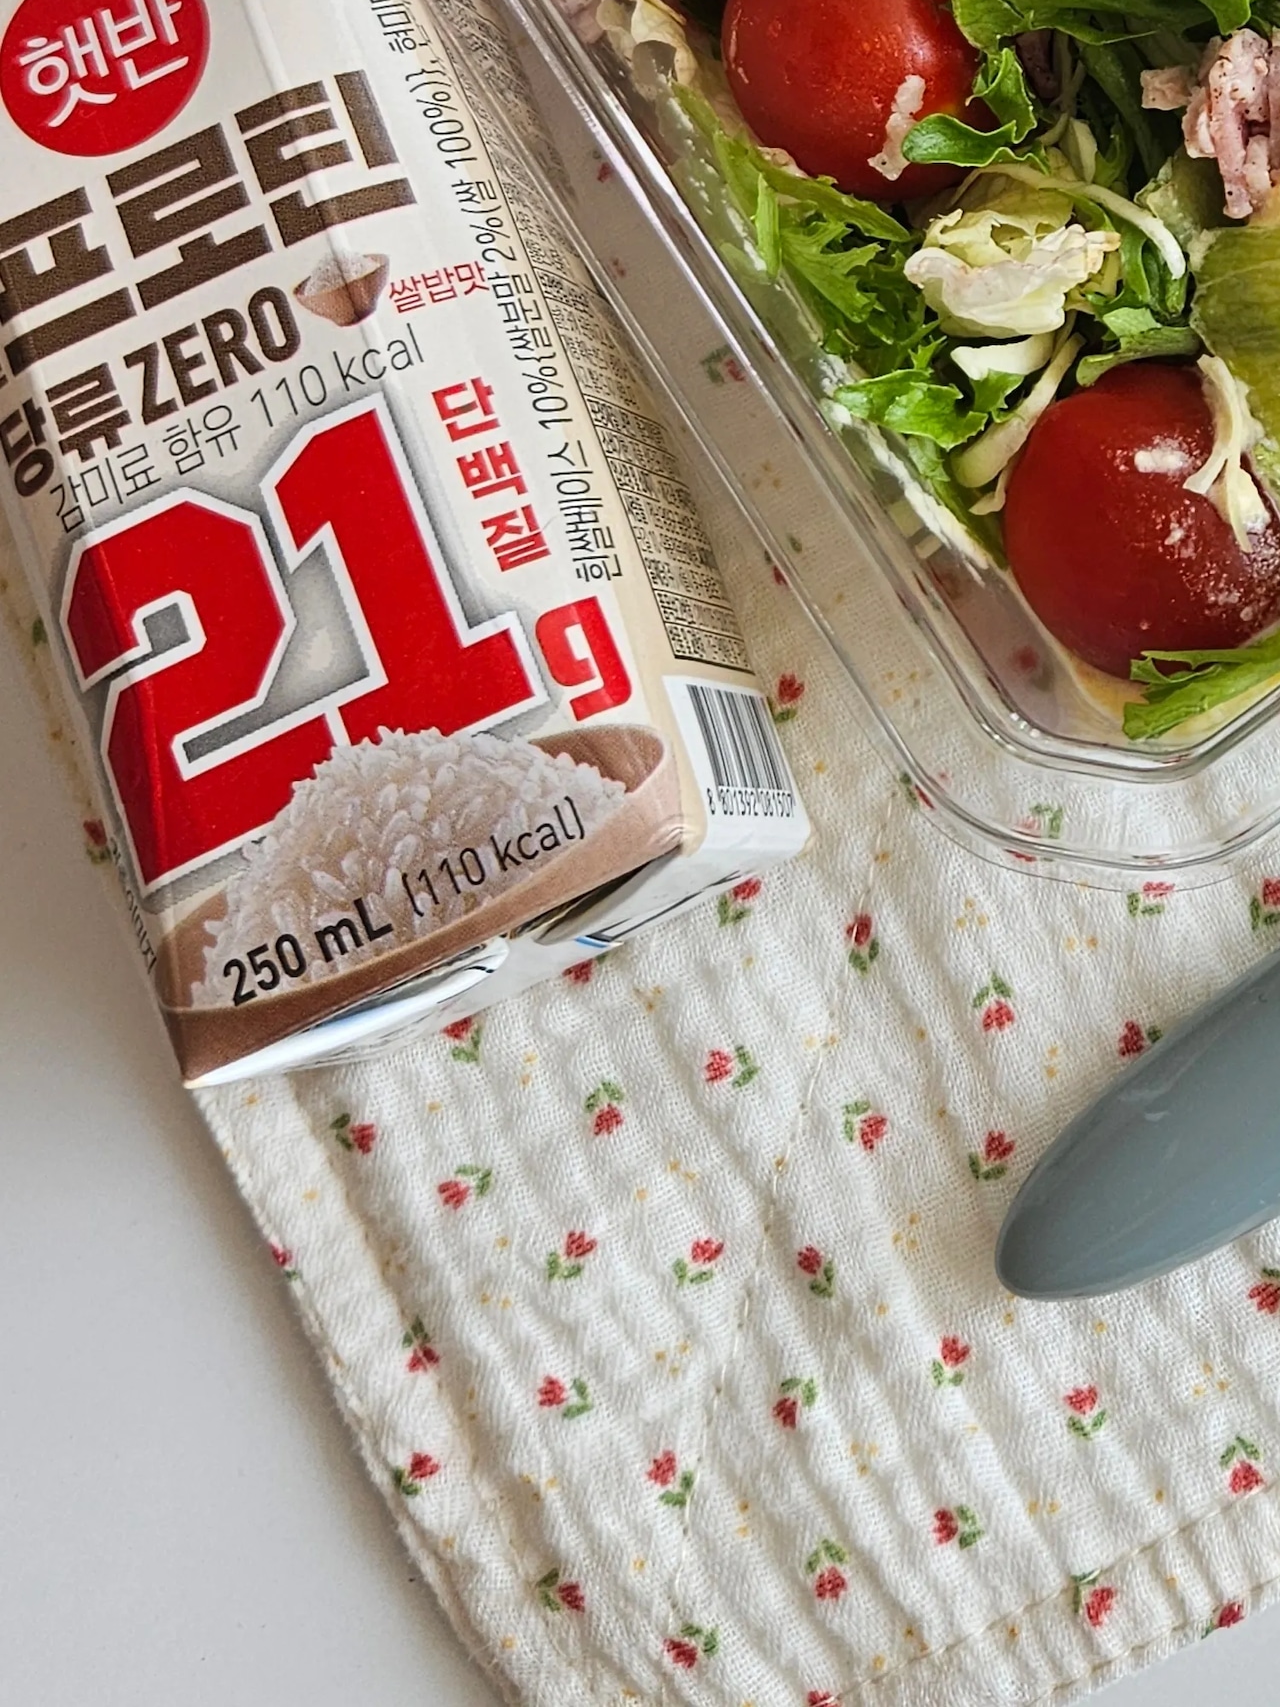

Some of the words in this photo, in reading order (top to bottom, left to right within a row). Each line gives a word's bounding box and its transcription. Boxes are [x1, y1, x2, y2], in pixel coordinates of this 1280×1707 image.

[123, 286, 301, 426] ZERO
[388, 260, 490, 314] 쌀밥맛
[50, 443, 161, 533] 감미료
[162, 404, 242, 476] 함유
[249, 364, 328, 428] 110
[332, 323, 425, 392] kcal
[431, 376, 552, 573] 단백질
[222, 933, 309, 1007] 250
[314, 897, 394, 963] mL
